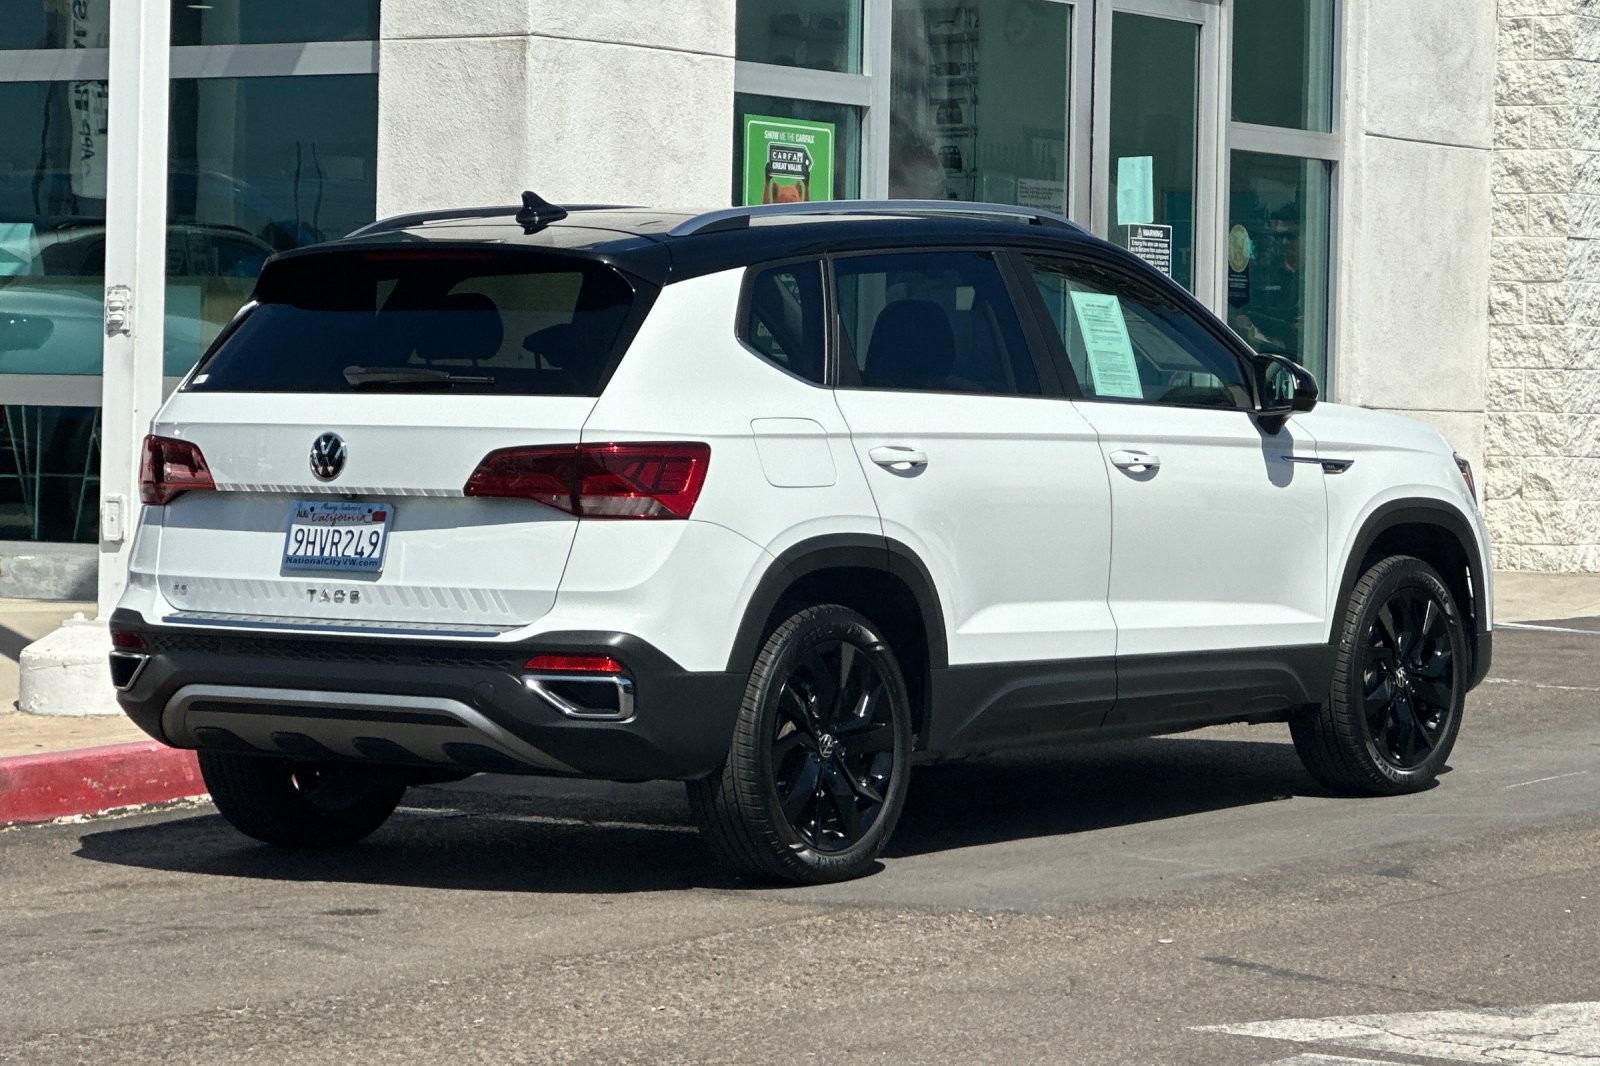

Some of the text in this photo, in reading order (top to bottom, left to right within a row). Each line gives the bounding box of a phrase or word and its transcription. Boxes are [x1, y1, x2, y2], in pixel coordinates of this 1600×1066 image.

[311, 511, 368, 527] California
[292, 528, 380, 558] 9HVR249
[286, 556, 378, 567] NationalCityVW.com
